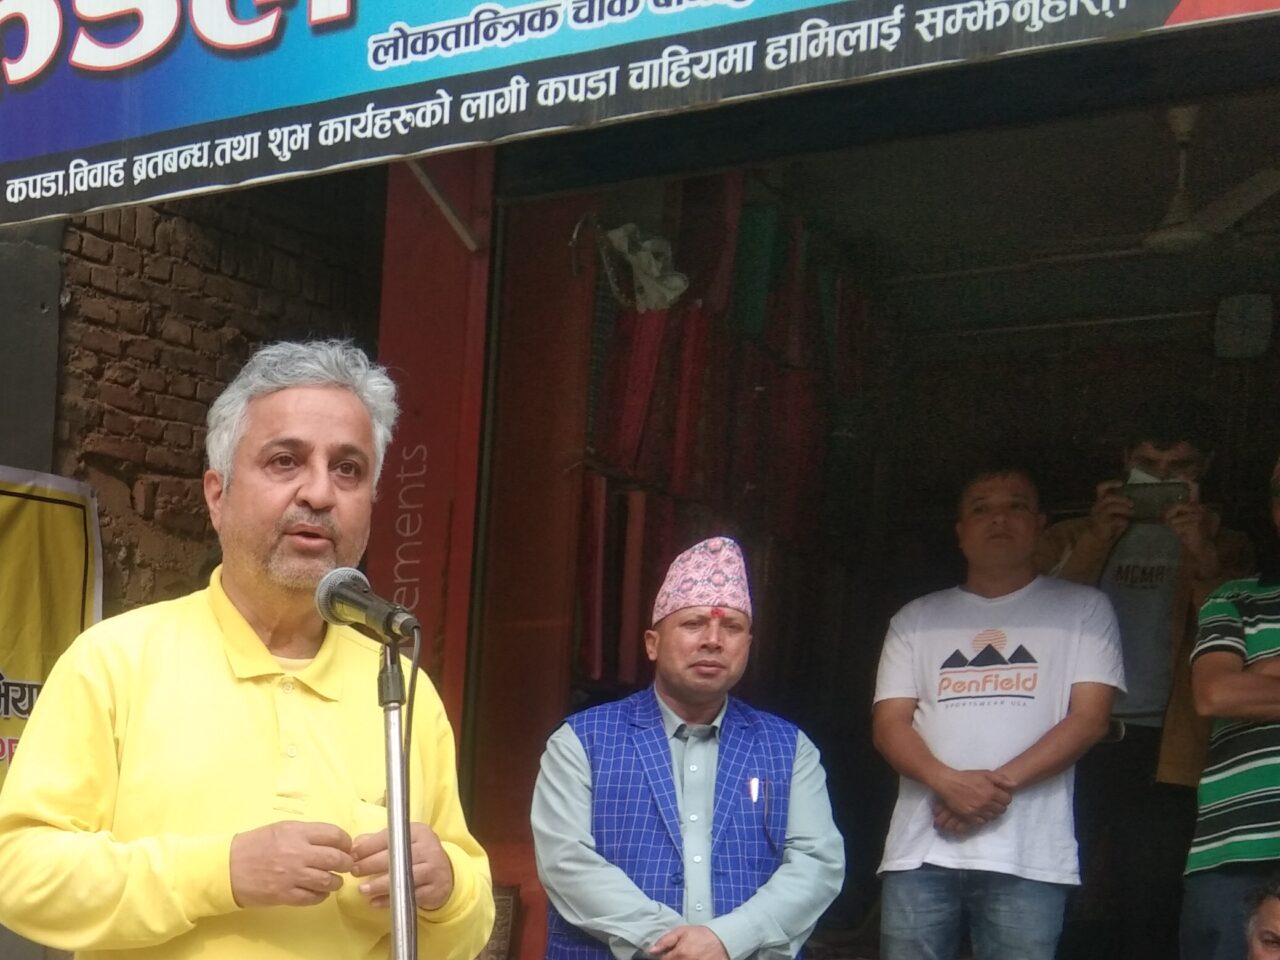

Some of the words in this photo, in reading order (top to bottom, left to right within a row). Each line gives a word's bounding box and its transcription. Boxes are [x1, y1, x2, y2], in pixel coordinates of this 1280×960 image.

[268, 122, 311, 162] शुभ
[460, 75, 530, 123] लागी
[537, 66, 620, 107] कपडा
